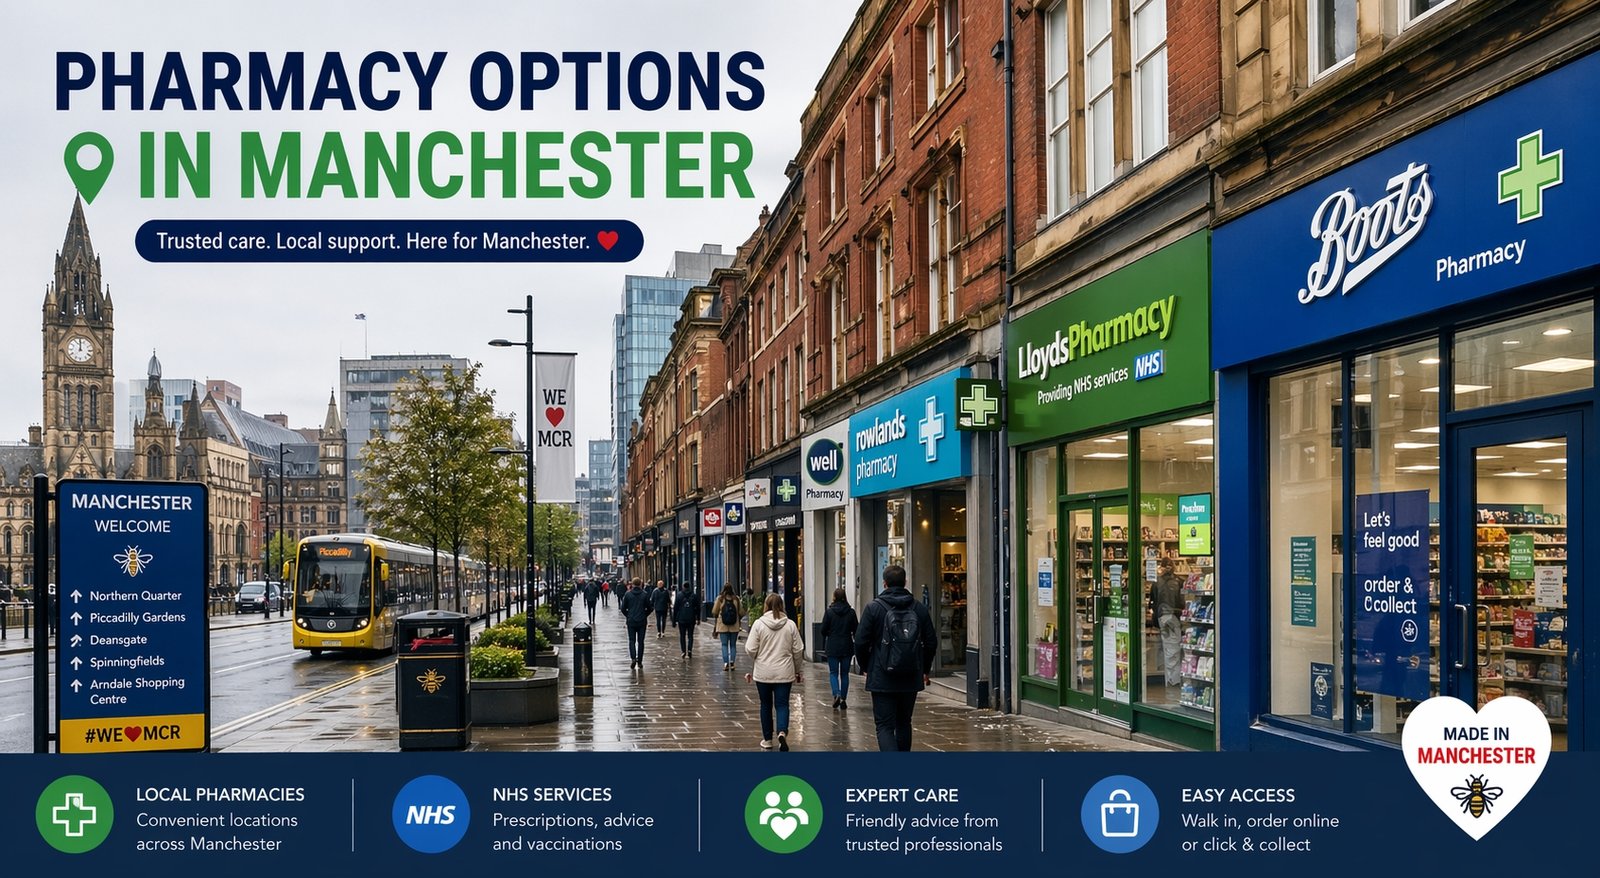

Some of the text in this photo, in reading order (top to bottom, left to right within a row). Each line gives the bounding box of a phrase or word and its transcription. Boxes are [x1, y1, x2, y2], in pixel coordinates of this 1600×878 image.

[1298, 162, 1435, 304] Boots
[1436, 239, 1526, 282] Pharmacy
[1018, 295, 1176, 380] LloydsPharmacy
[1135, 351, 1161, 378] NHS
[1038, 367, 1129, 405] Providing NHS services
[543, 389, 566, 405] WE
[538, 430, 572, 447] MCR
[856, 409, 906, 452] rowlands
[810, 449, 838, 471] well
[856, 452, 898, 485] pharmacy
[72, 494, 192, 511] MANCHESTER
[806, 488, 844, 501] Pharmacy
[94, 520, 171, 532] WELCOME
[1364, 511, 1391, 528] Let's
[1364, 530, 1419, 552] feel good
[1364, 575, 1414, 594] order &
[90, 590, 182, 602] Northern Quarter
[90, 612, 186, 625] Piccadilly Gardens
[90, 635, 148, 647] Deansgate
[90, 655, 165, 670] Spinningfields
[90, 677, 185, 691] Arndale Shopping
[90, 694, 127, 705] Centre
